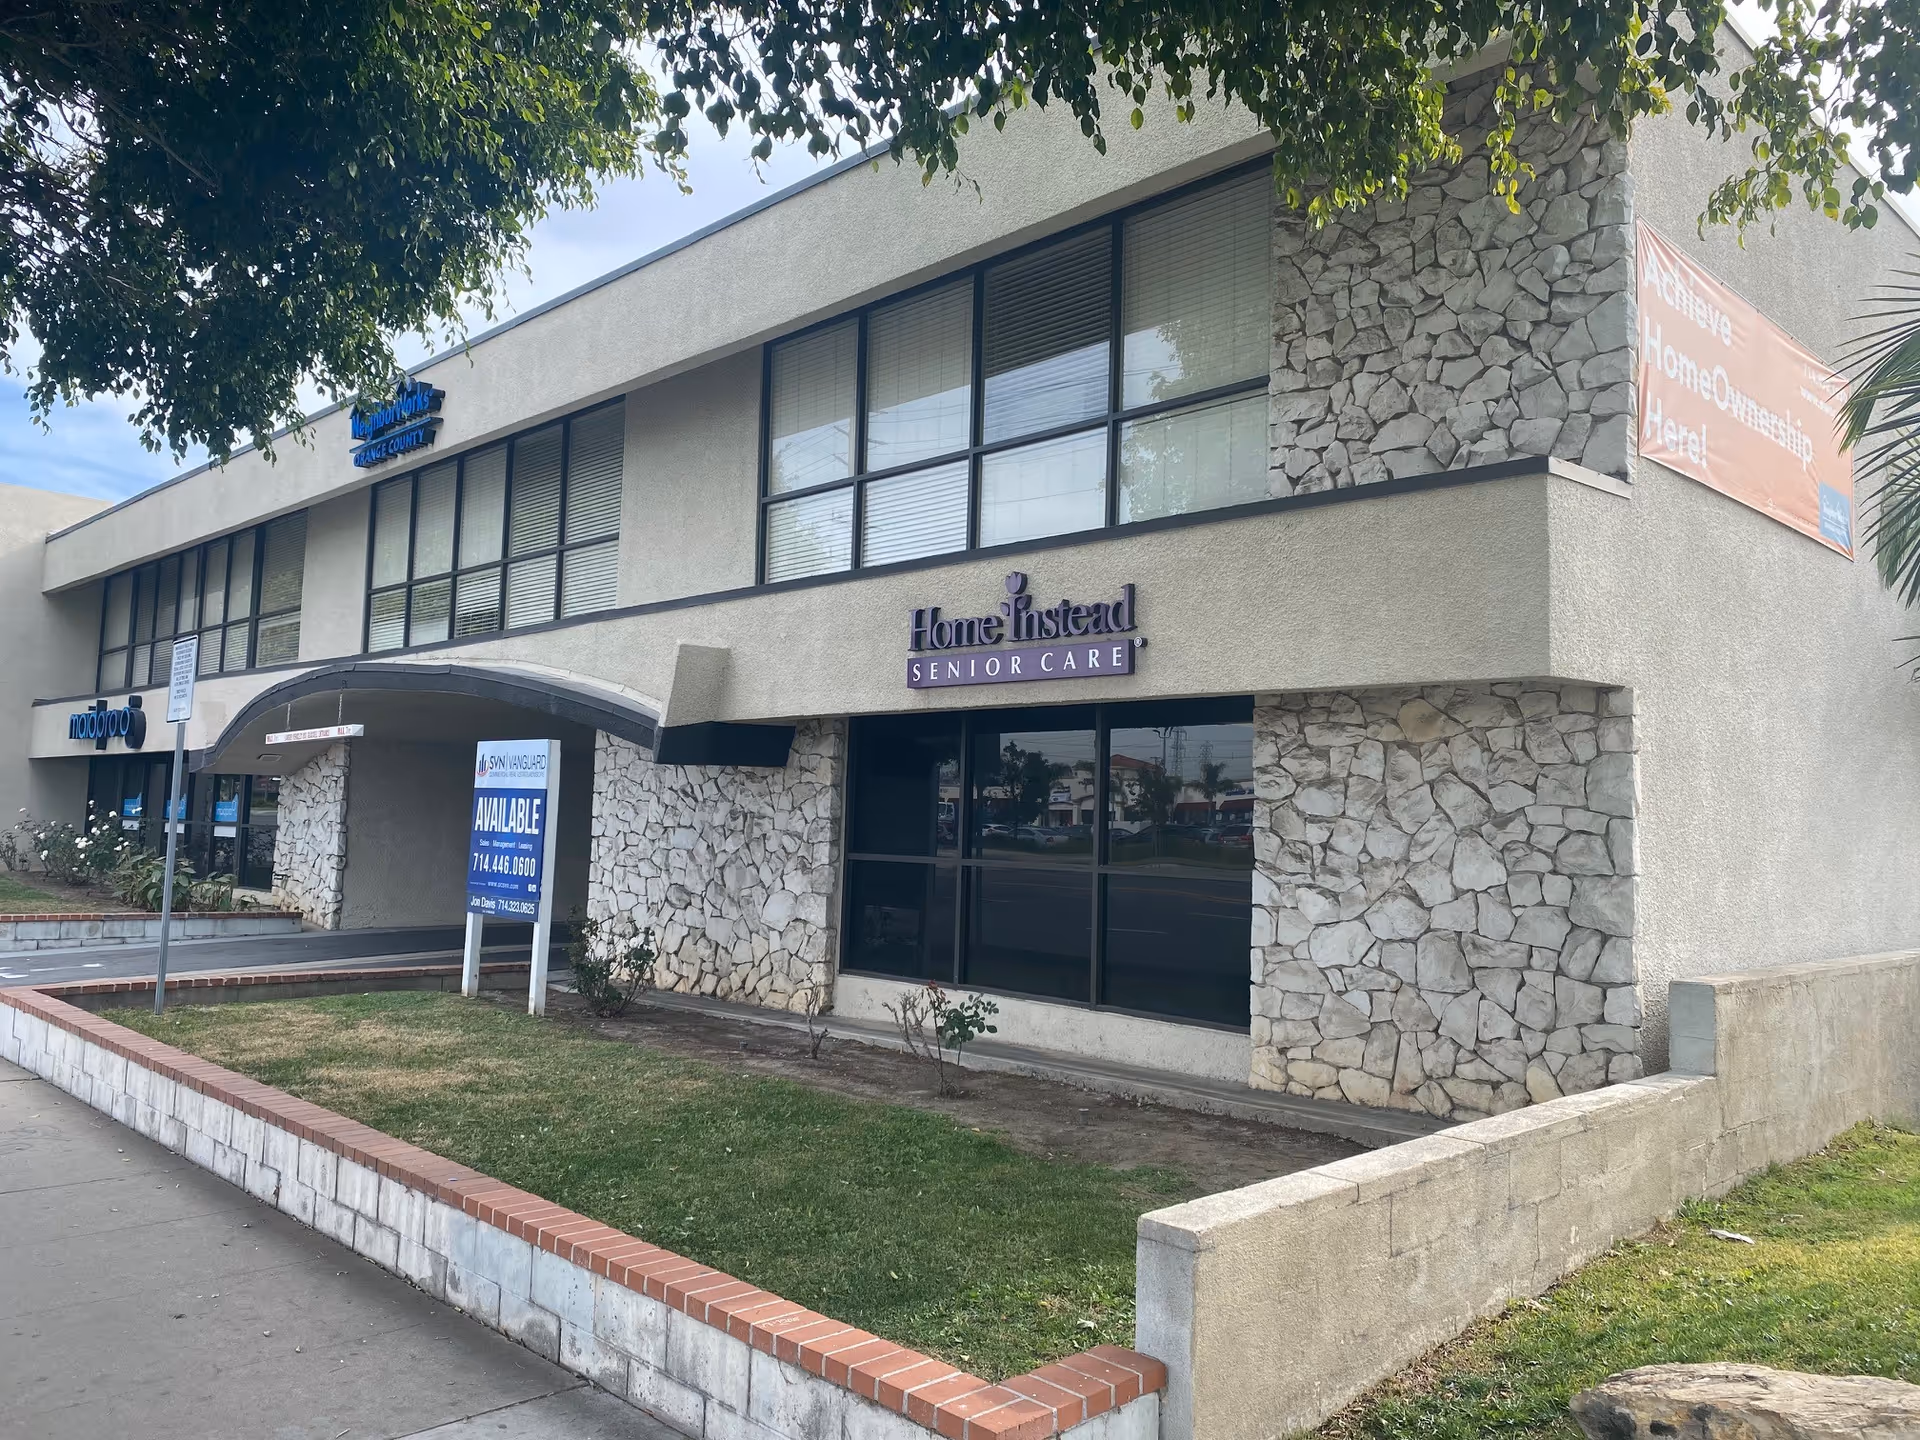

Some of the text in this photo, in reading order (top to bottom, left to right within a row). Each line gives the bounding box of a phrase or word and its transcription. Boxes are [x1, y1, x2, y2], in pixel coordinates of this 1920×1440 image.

[1643, 252, 1733, 346] Achieve
[1644, 316, 1813, 472] HomeOwnership
[353, 427, 425, 467] ORANGE COUNTY
[1645, 391, 1707, 468] Here!
[907, 583, 1138, 652] Home Instead
[912, 646, 1123, 682] SENIOR CARE
[489, 754, 547, 770] SVN VANGUARD
[474, 797, 541, 834] AVAILABLE
[479, 838, 490, 847] Sales
[492, 840, 516, 850] Management
[472, 852, 536, 877] 714.446.0600
[470, 895, 480, 907] Jon
[481, 896, 496, 910] Davis
